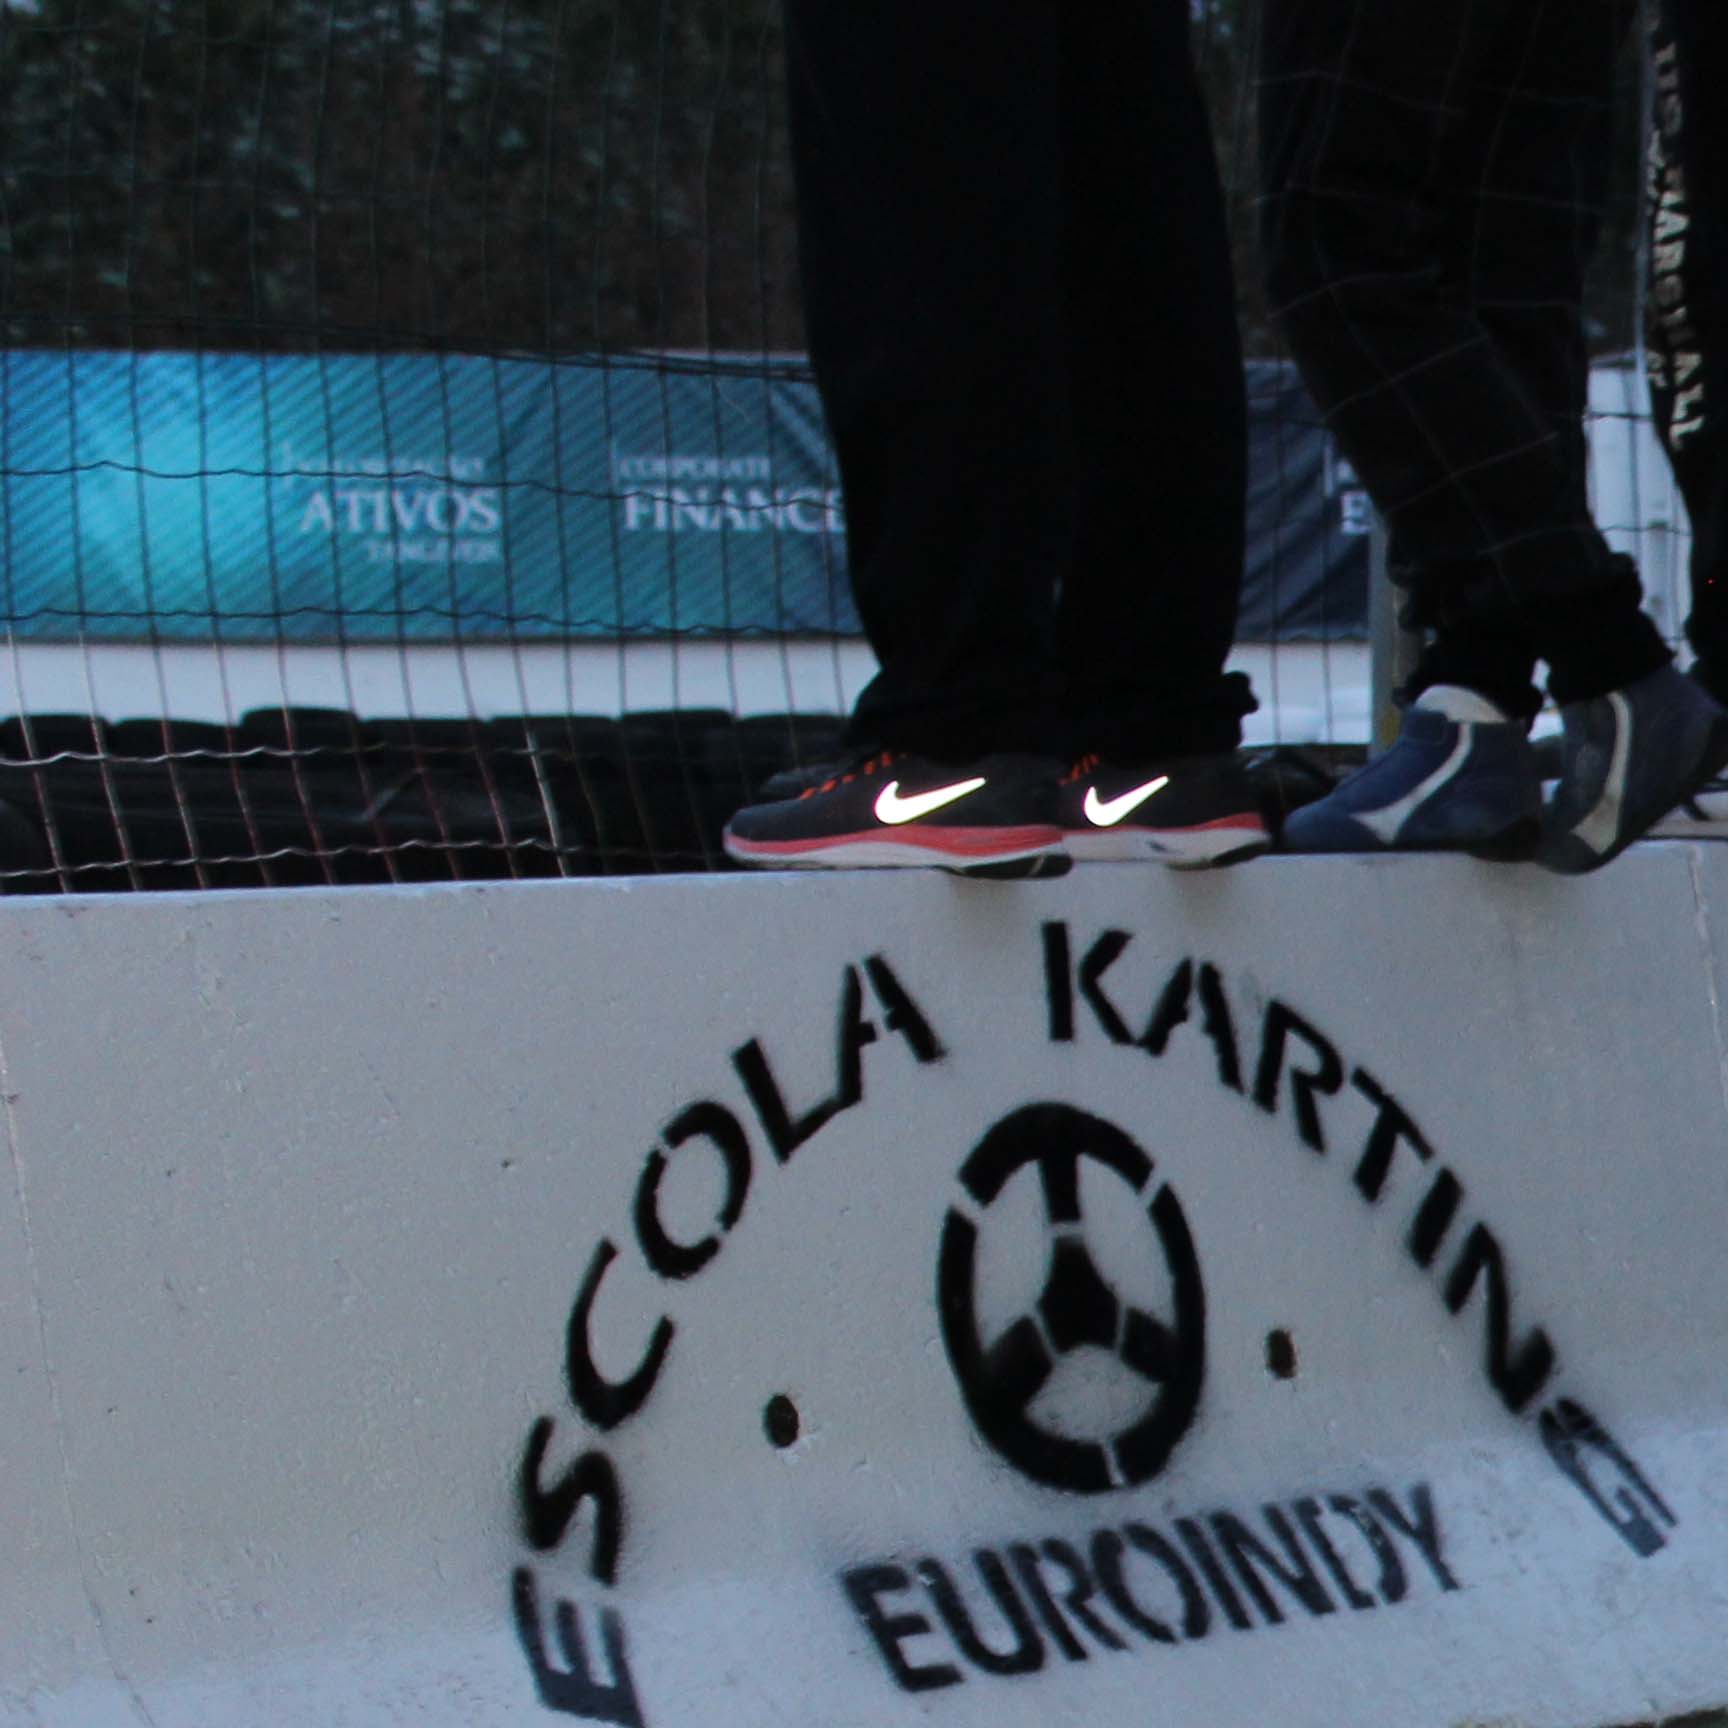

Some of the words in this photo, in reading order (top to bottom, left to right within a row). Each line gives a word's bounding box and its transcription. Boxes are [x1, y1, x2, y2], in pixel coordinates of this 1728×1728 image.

[299, 488, 502, 533] ATIVOS
[1040, 920, 1681, 1560] KARTING
[840, 1482, 1465, 1693] EUROINDY
